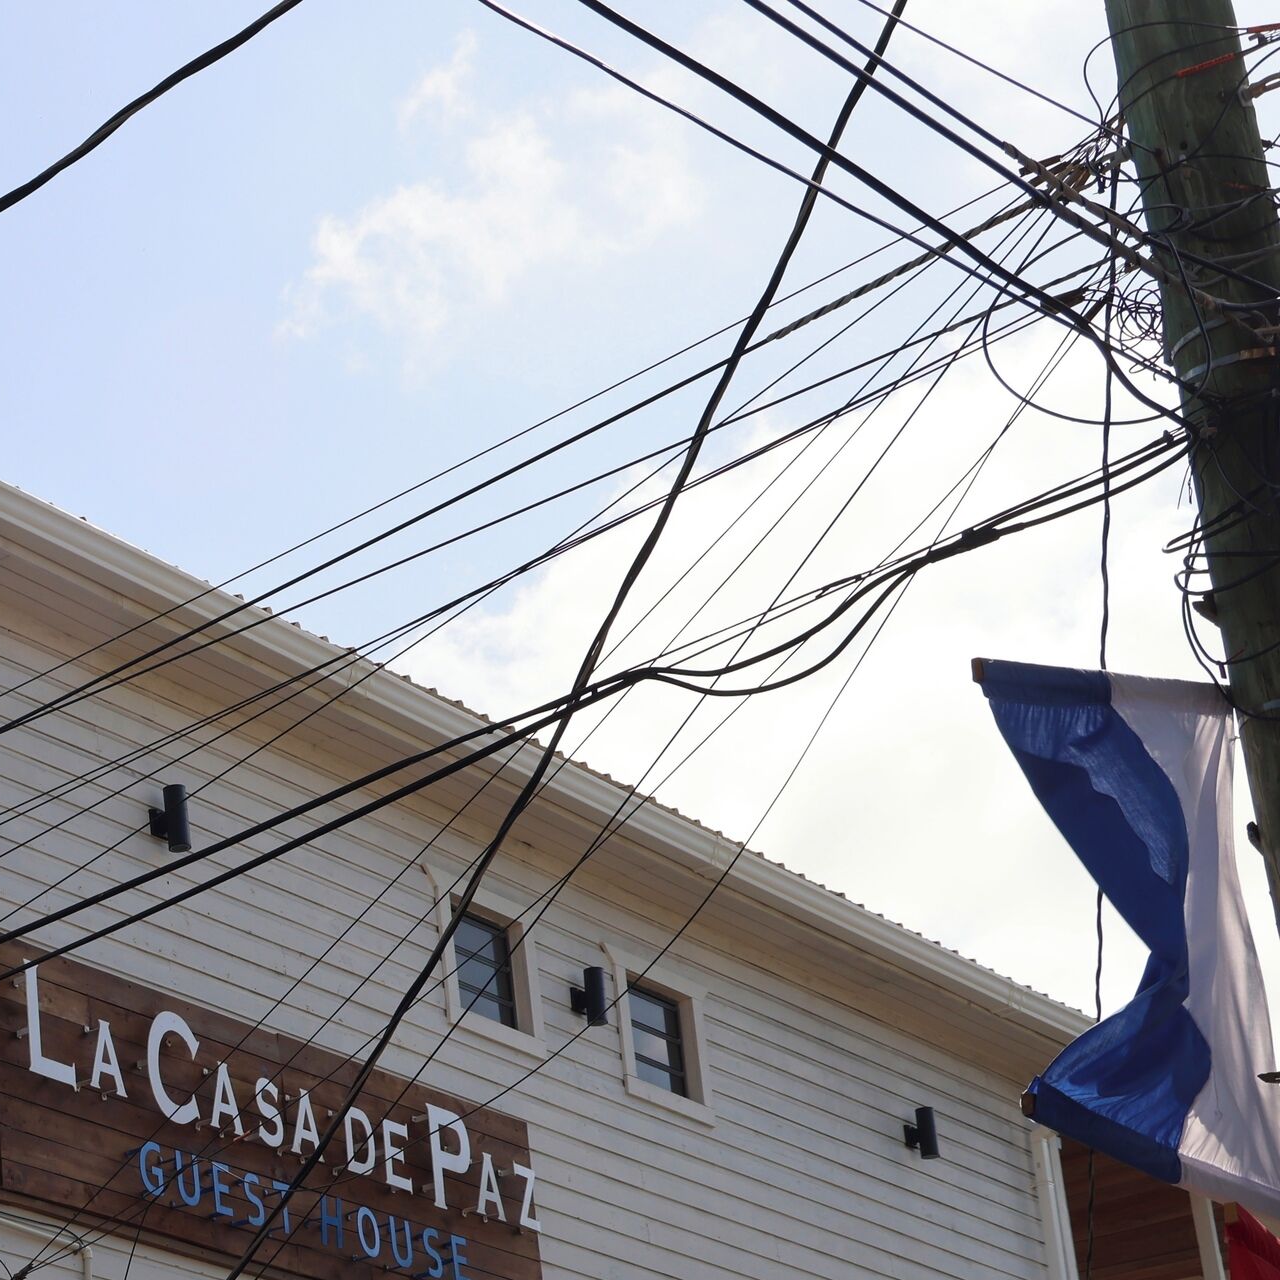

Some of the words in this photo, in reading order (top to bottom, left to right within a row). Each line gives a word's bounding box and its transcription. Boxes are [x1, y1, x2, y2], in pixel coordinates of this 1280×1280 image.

[22, 958, 128, 1099] LA
[147, 1010, 326, 1164] CASA
[344, 1105, 414, 1196] DE
[425, 1102, 542, 1233] PAZ
[138, 1140, 291, 1235] GUEST
